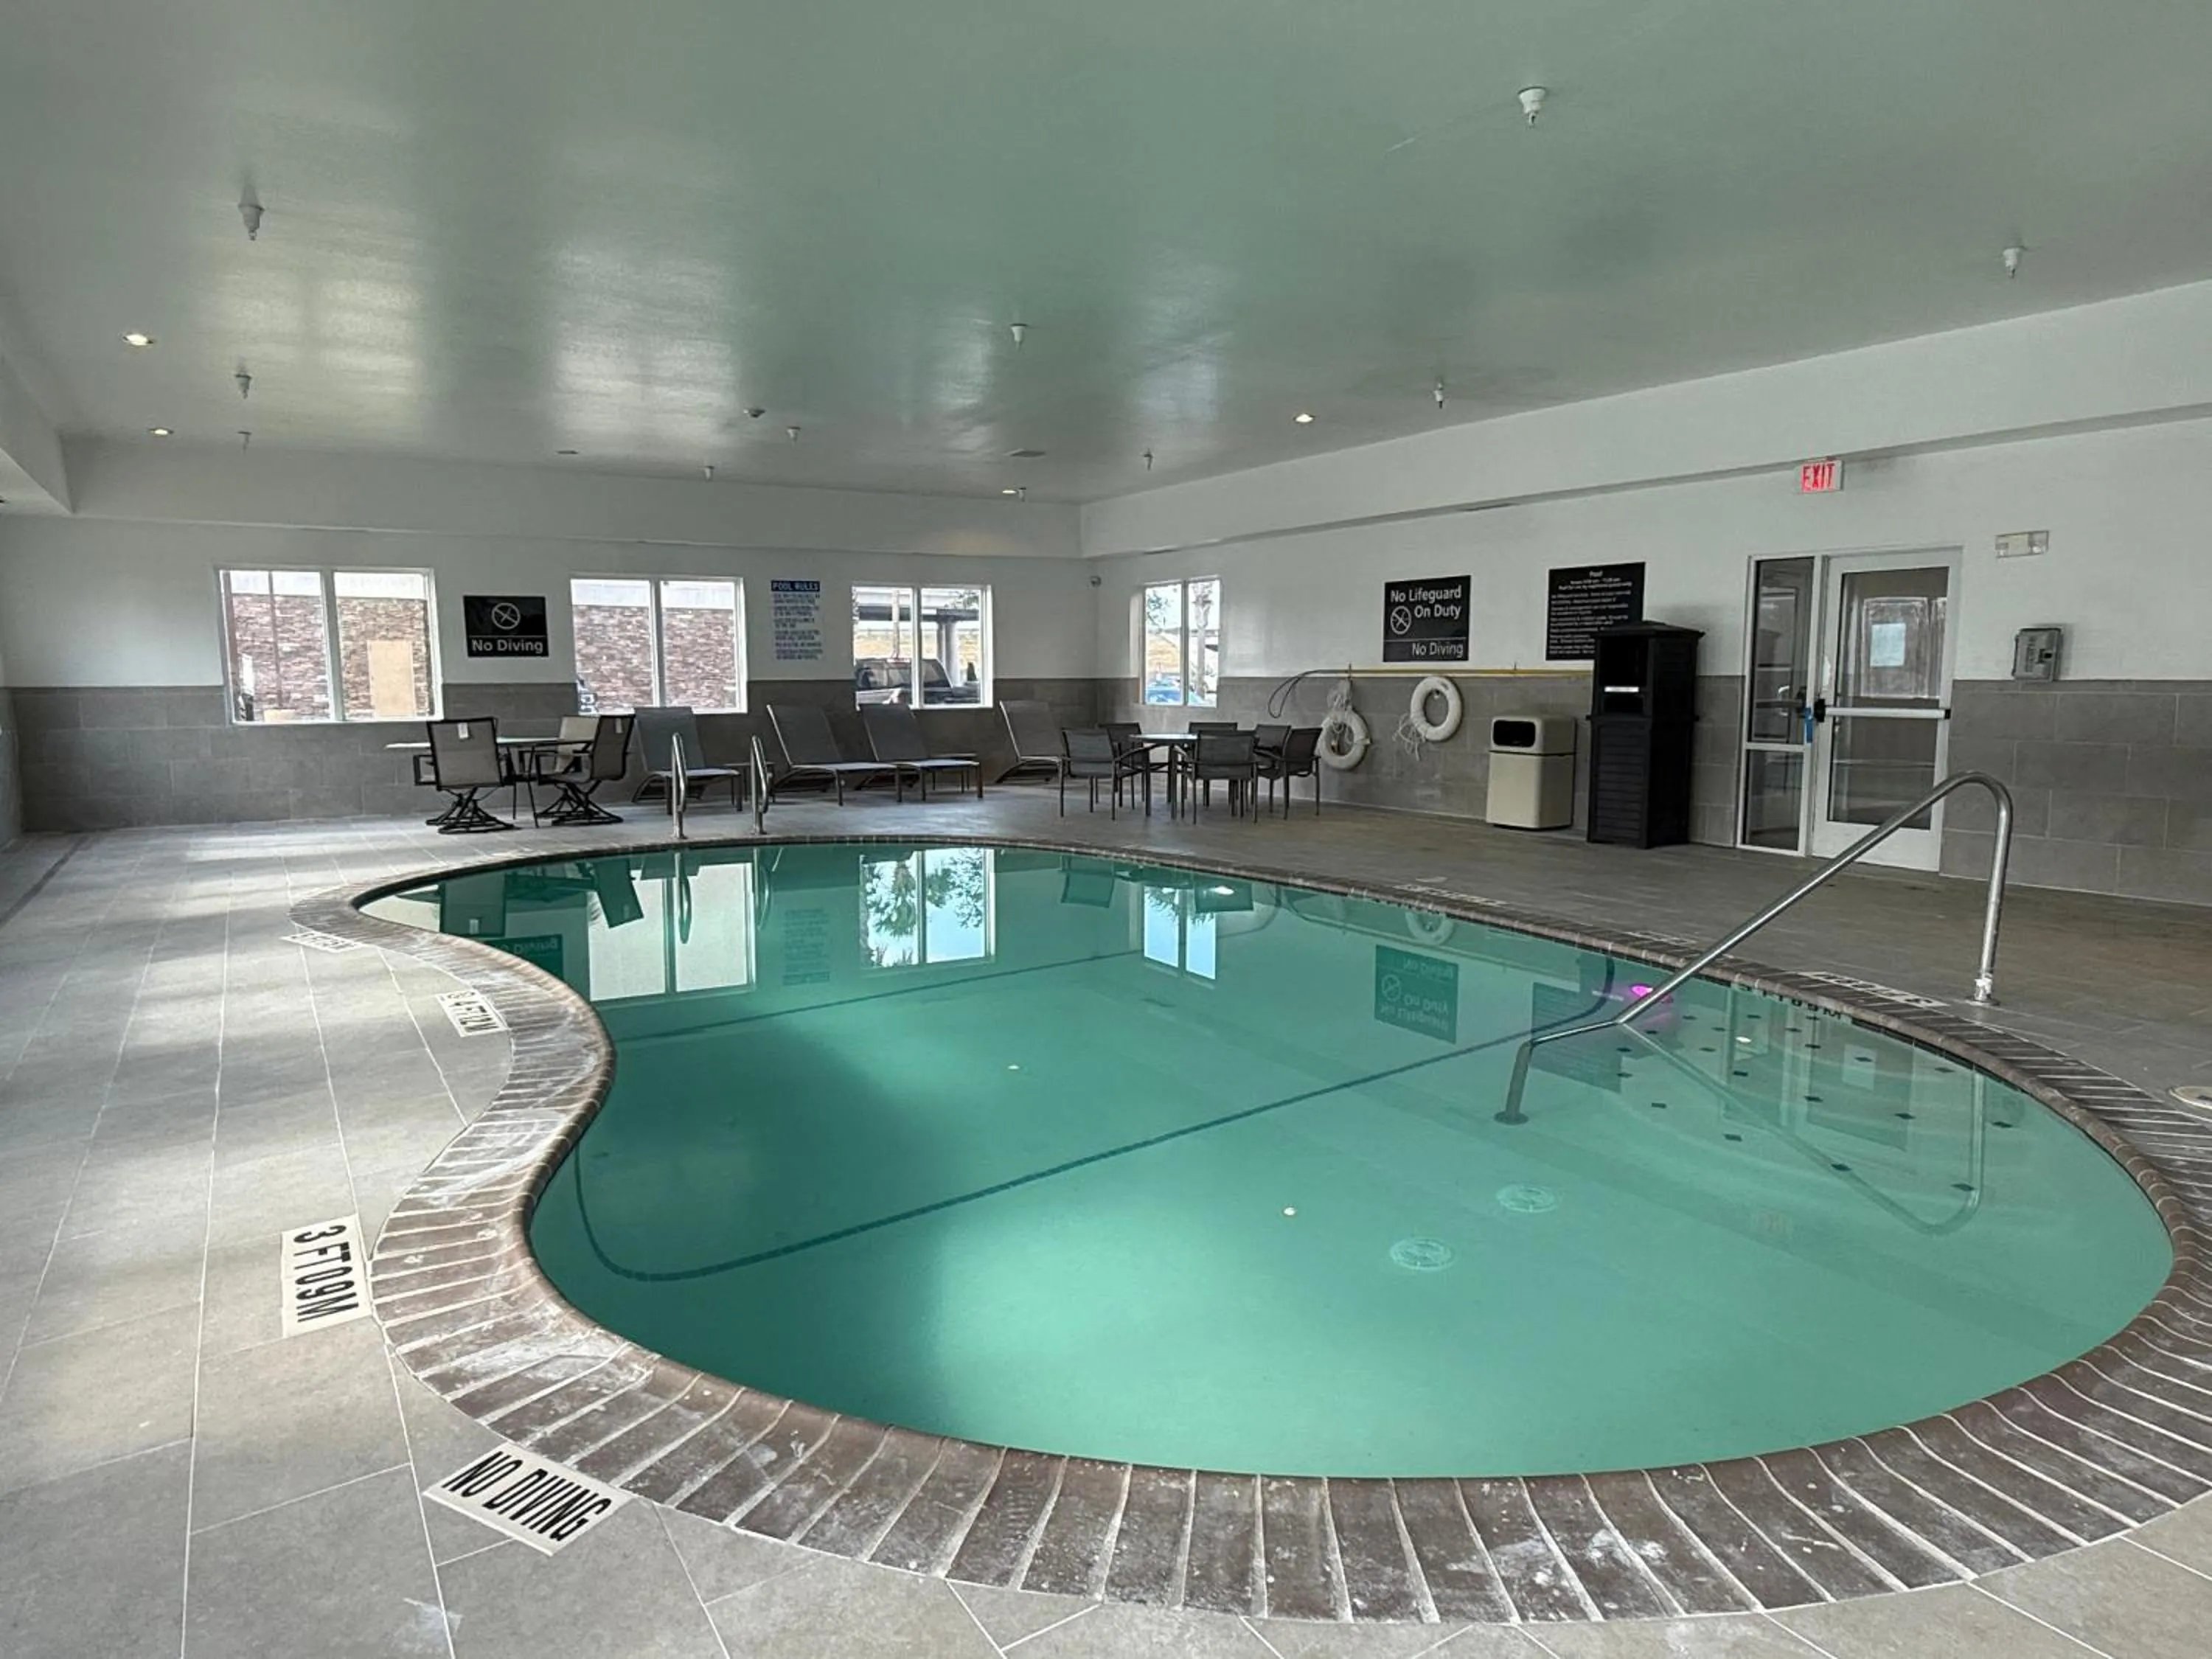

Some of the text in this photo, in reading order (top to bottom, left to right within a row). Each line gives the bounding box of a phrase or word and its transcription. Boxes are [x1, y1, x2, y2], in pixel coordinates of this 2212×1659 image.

[1802, 463, 1835, 491] EXIT
[773, 582, 792, 591] POOL
[1390, 584, 1462, 604] No Lifeguard
[1414, 604, 1461, 620] On Duty
[472, 638, 543, 654] No Diving
[1412, 641, 1464, 658] No Diving
[441, 1450, 612, 1542] NO DIVING
